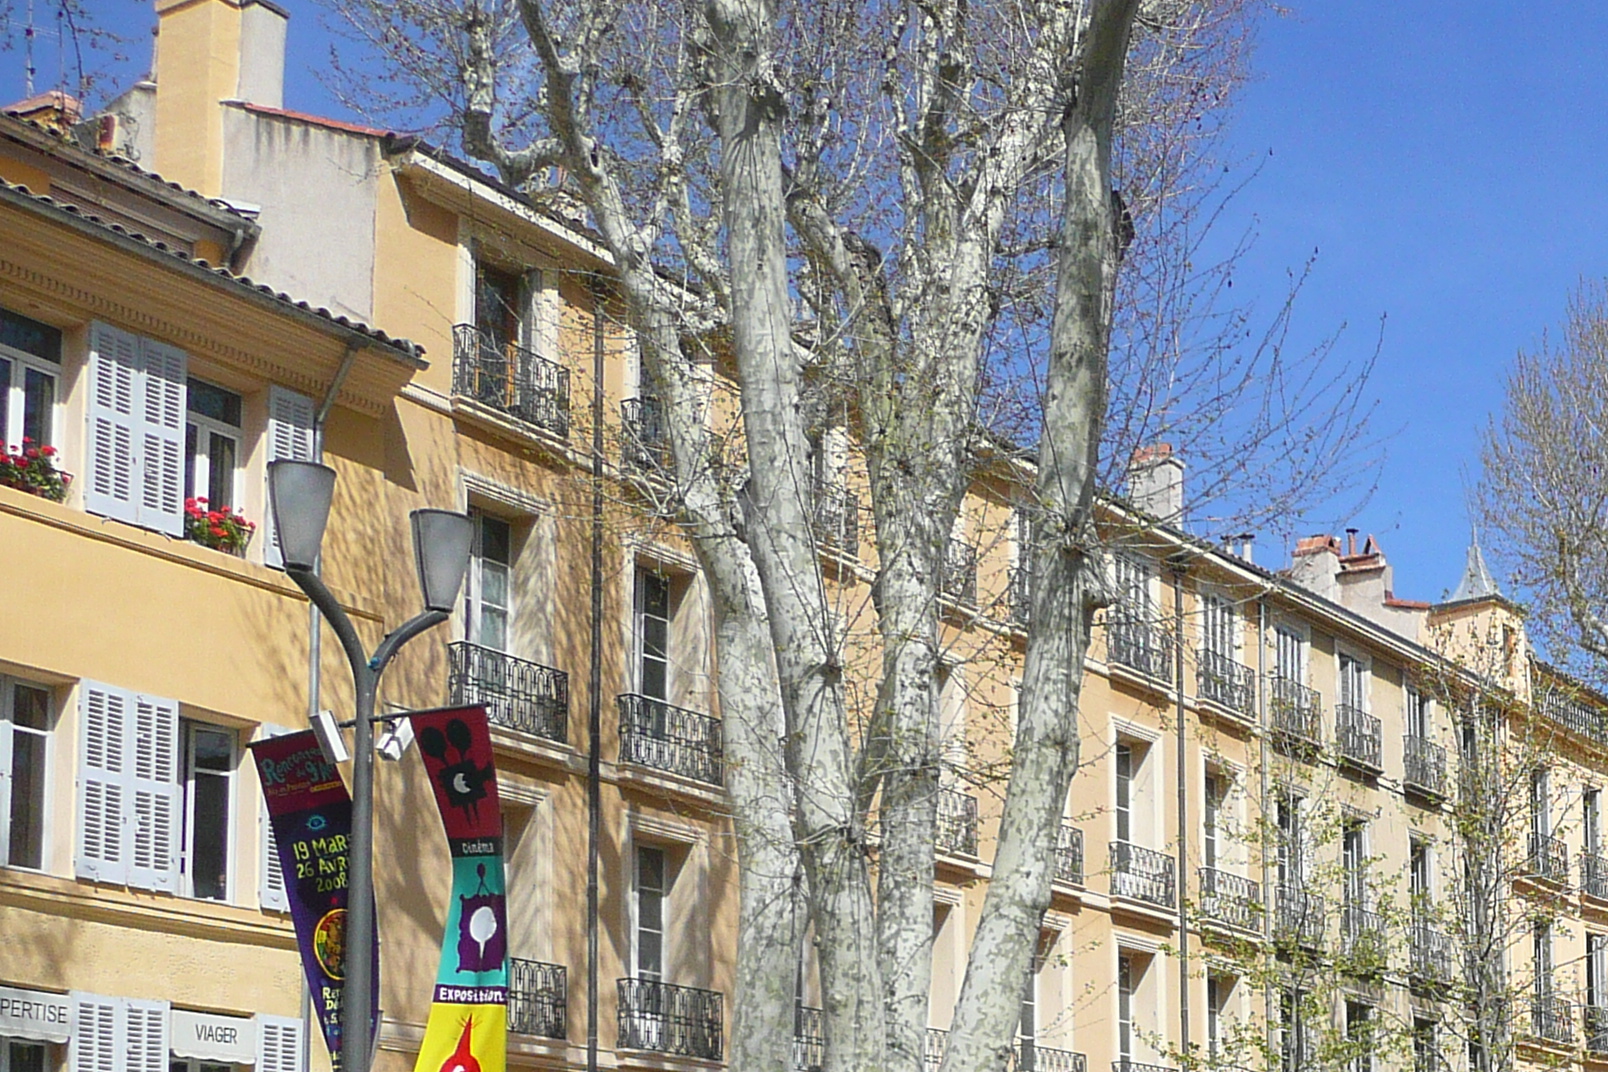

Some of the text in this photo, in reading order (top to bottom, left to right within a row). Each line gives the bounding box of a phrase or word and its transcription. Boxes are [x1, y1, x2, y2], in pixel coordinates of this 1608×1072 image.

[293, 841, 310, 861] 19
[296, 861, 315, 879] 26
[315, 872, 349, 893] 2008
[0, 997, 68, 1025] PERTISE
[195, 1023, 238, 1045] VIAGER
